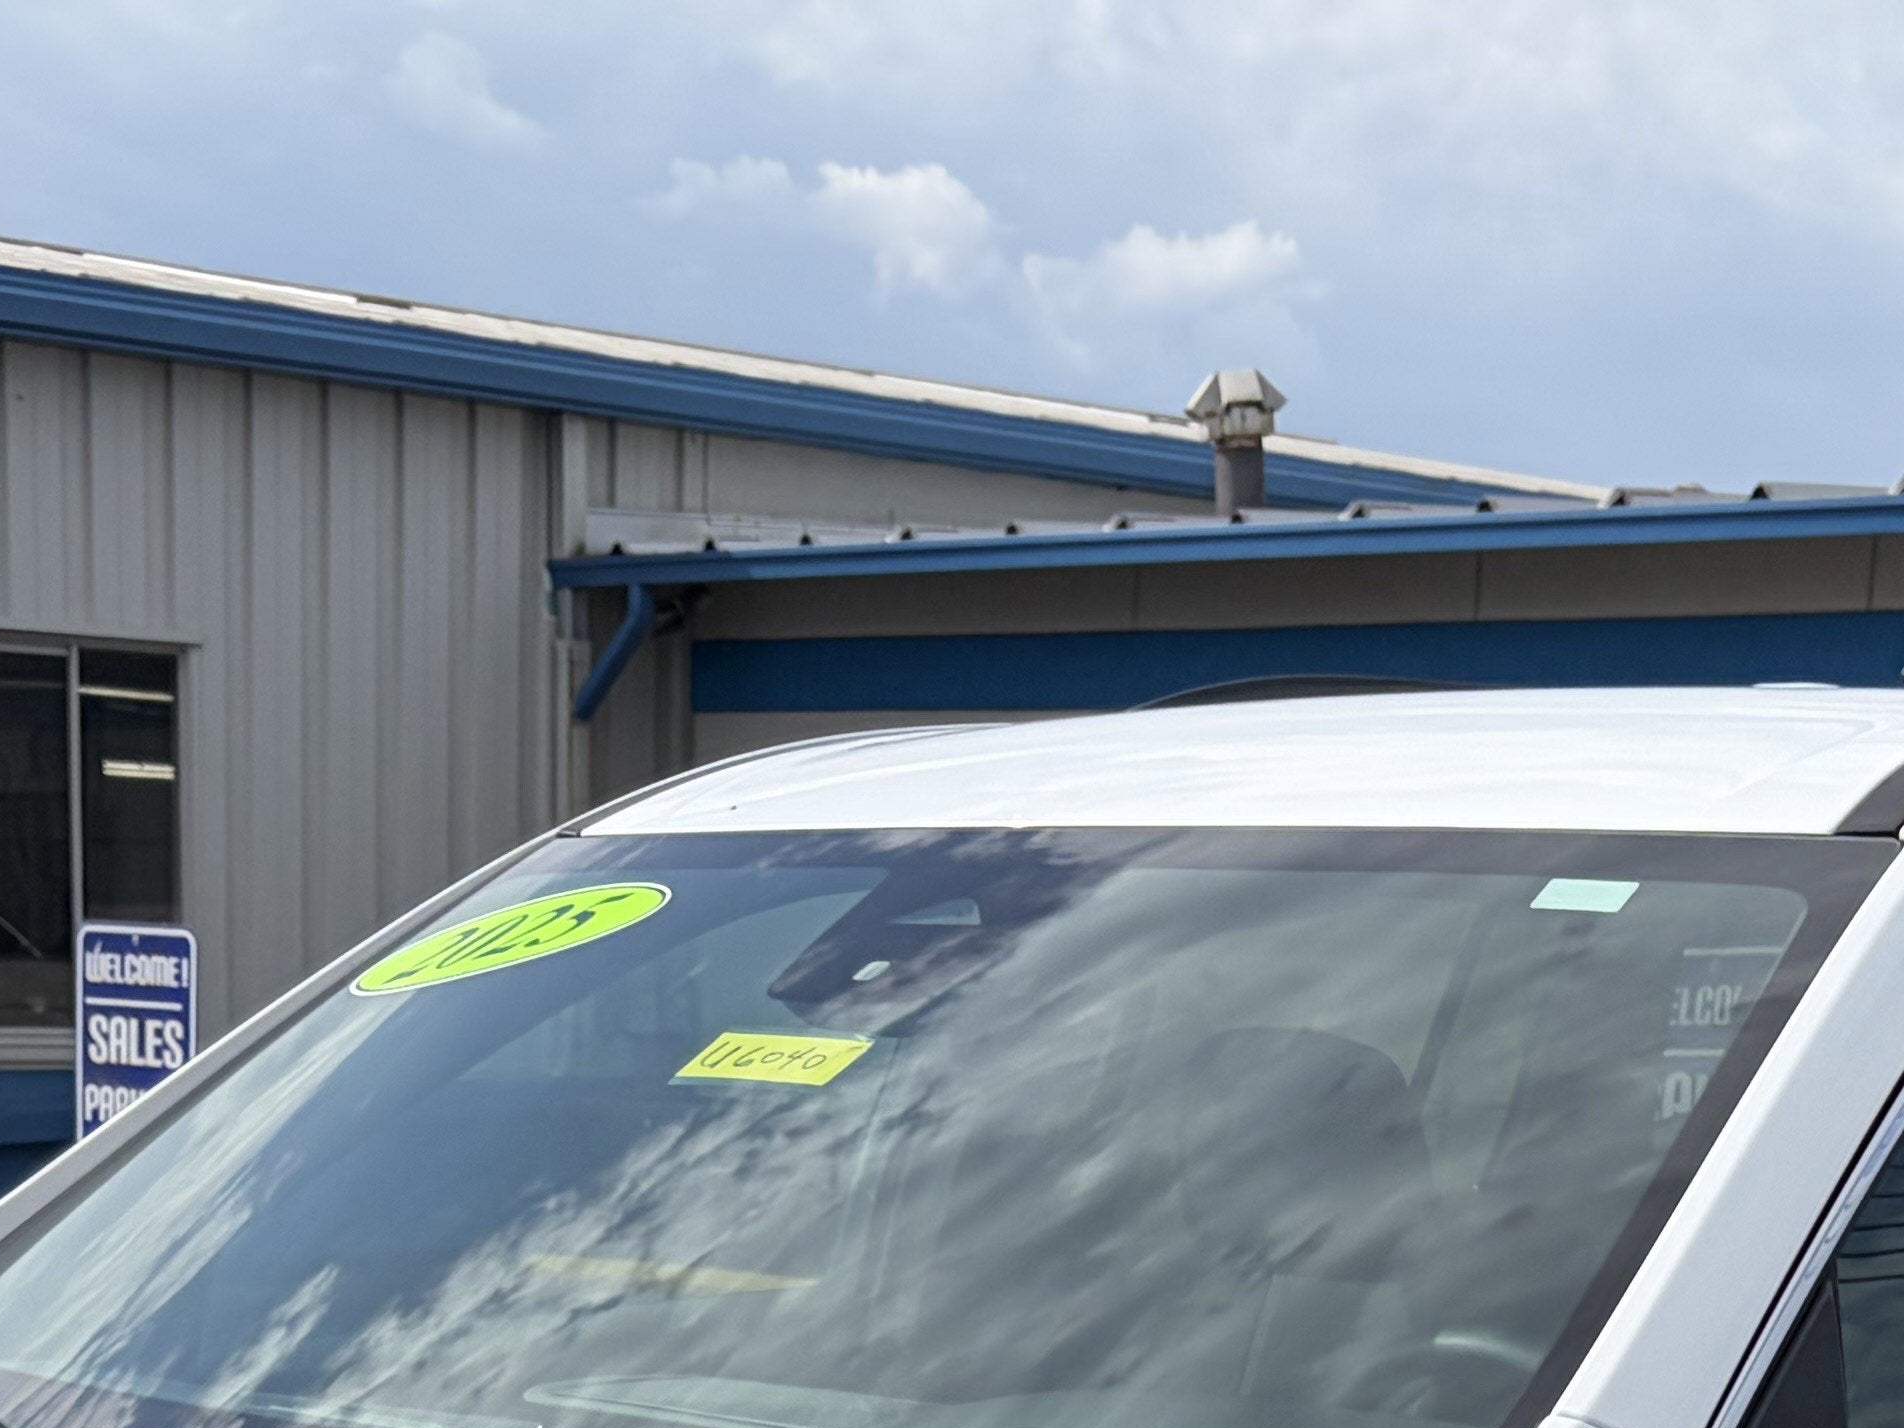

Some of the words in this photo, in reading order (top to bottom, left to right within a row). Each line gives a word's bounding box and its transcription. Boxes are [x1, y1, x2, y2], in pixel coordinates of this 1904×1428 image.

[85, 941, 189, 988] WELCOME!
[381, 893, 636, 985] 2025
[88, 1013, 184, 1069] SALES
